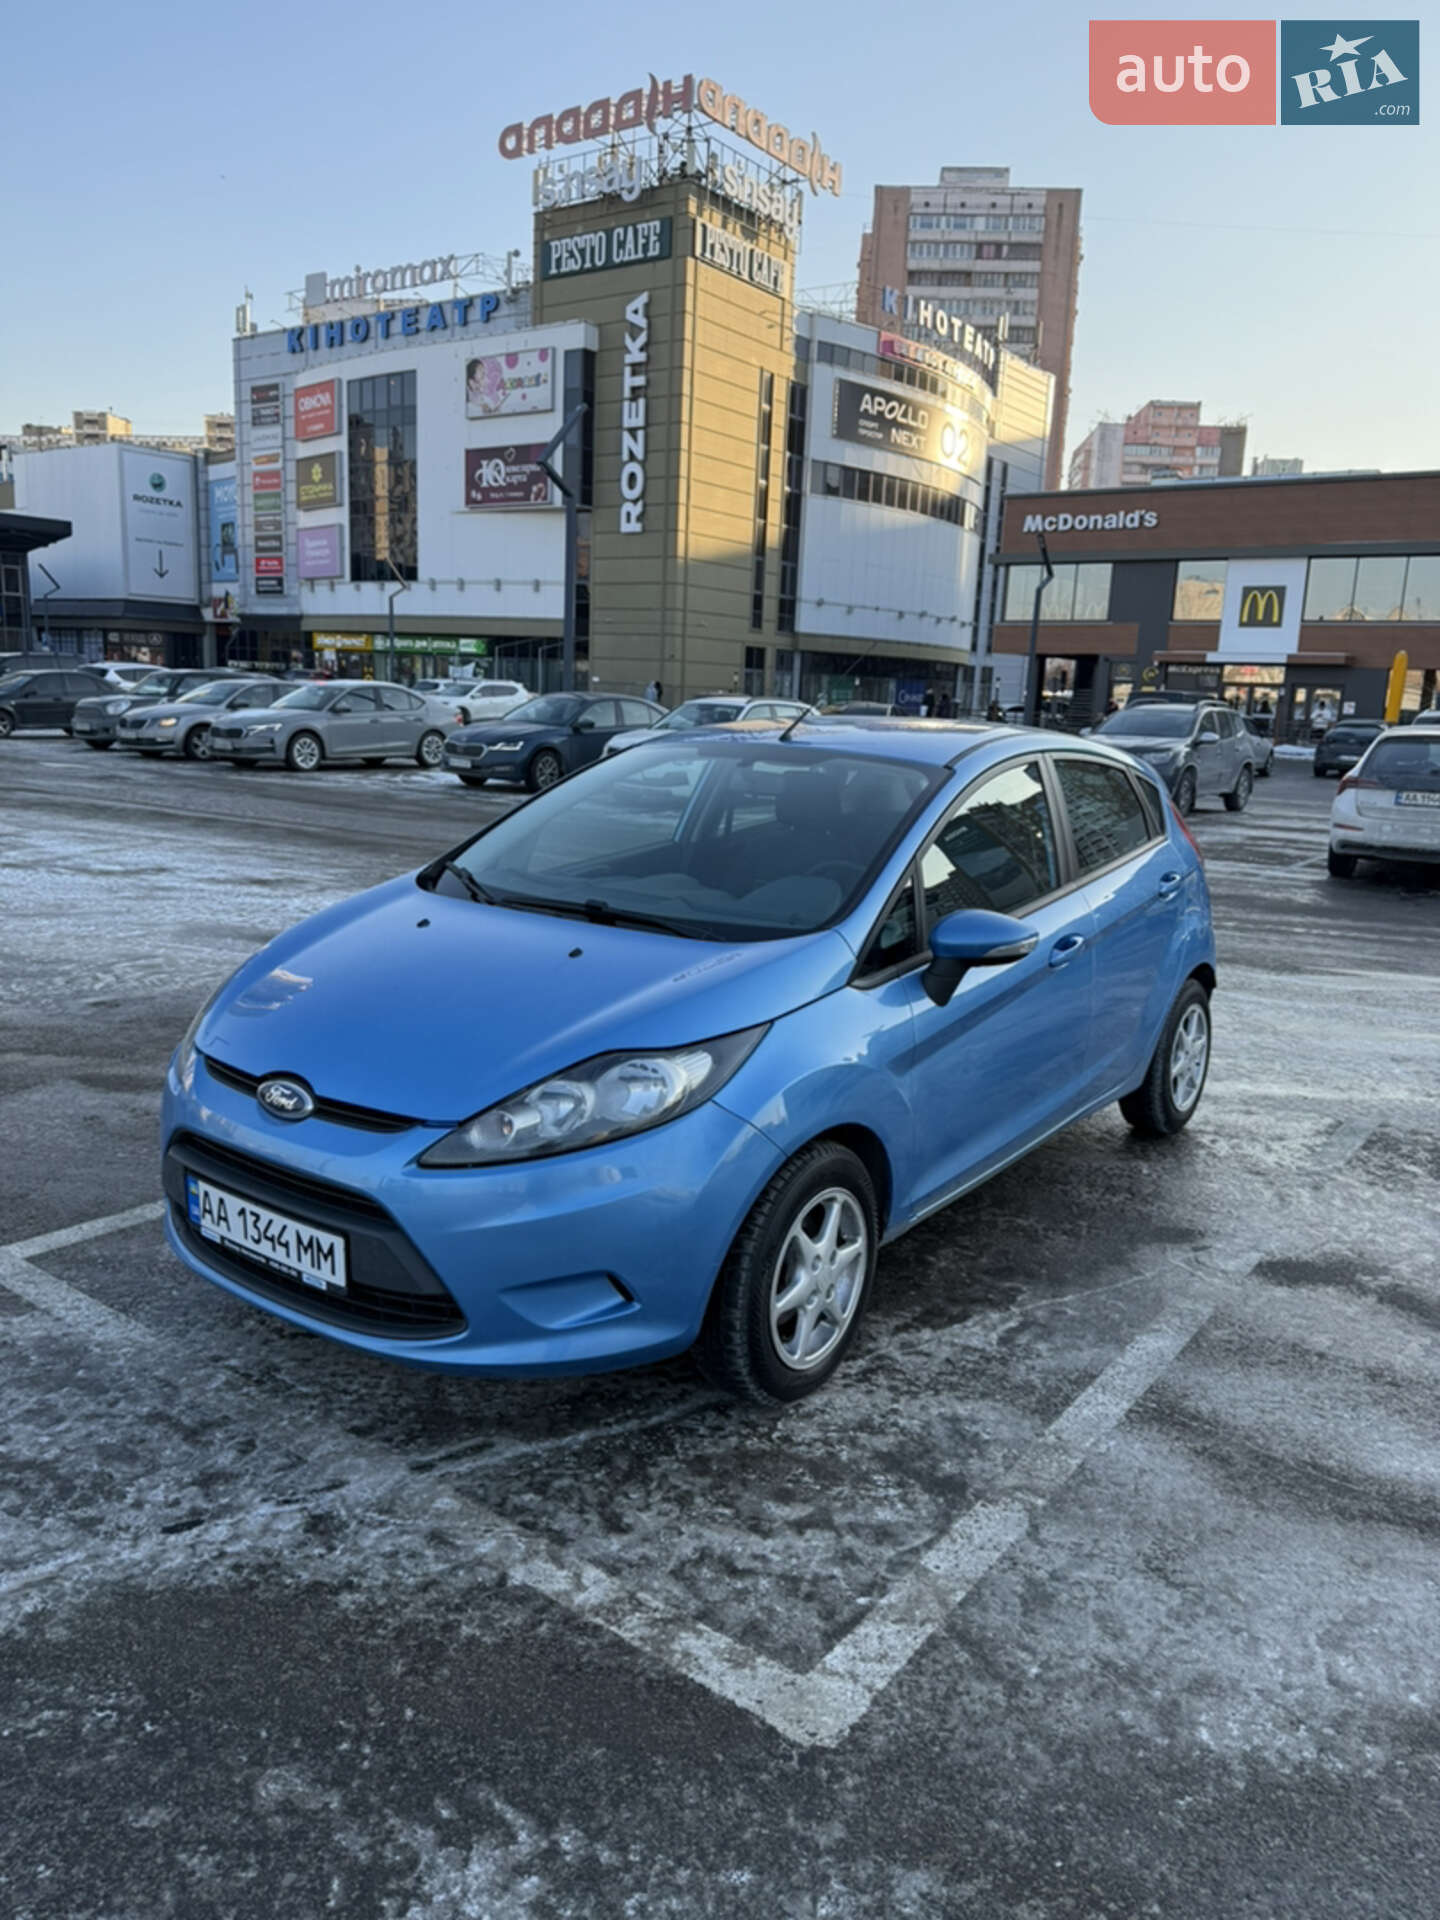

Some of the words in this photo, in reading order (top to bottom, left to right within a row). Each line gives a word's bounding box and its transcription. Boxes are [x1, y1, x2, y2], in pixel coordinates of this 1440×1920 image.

[724, 158, 801, 241] sinsay
[550, 230, 606, 275] PESTO
[613, 220, 661, 263] CAFE
[705, 225, 748, 280] PESTO
[753, 248, 785, 294] CAFE
[329, 253, 455, 300] miromax
[286, 294, 500, 353] КІНОТЕАТР
[620, 291, 649, 533] ROZETKA
[859, 393, 929, 430] APOLLO
[890, 427, 926, 449] NEXT
[1022, 509, 1159, 533] McDonald's
[265, 1084, 298, 1110] Ford
[202, 1190, 231, 1233] AA
[237, 1207, 290, 1258] 1344
[296, 1229, 336, 1276] MM
